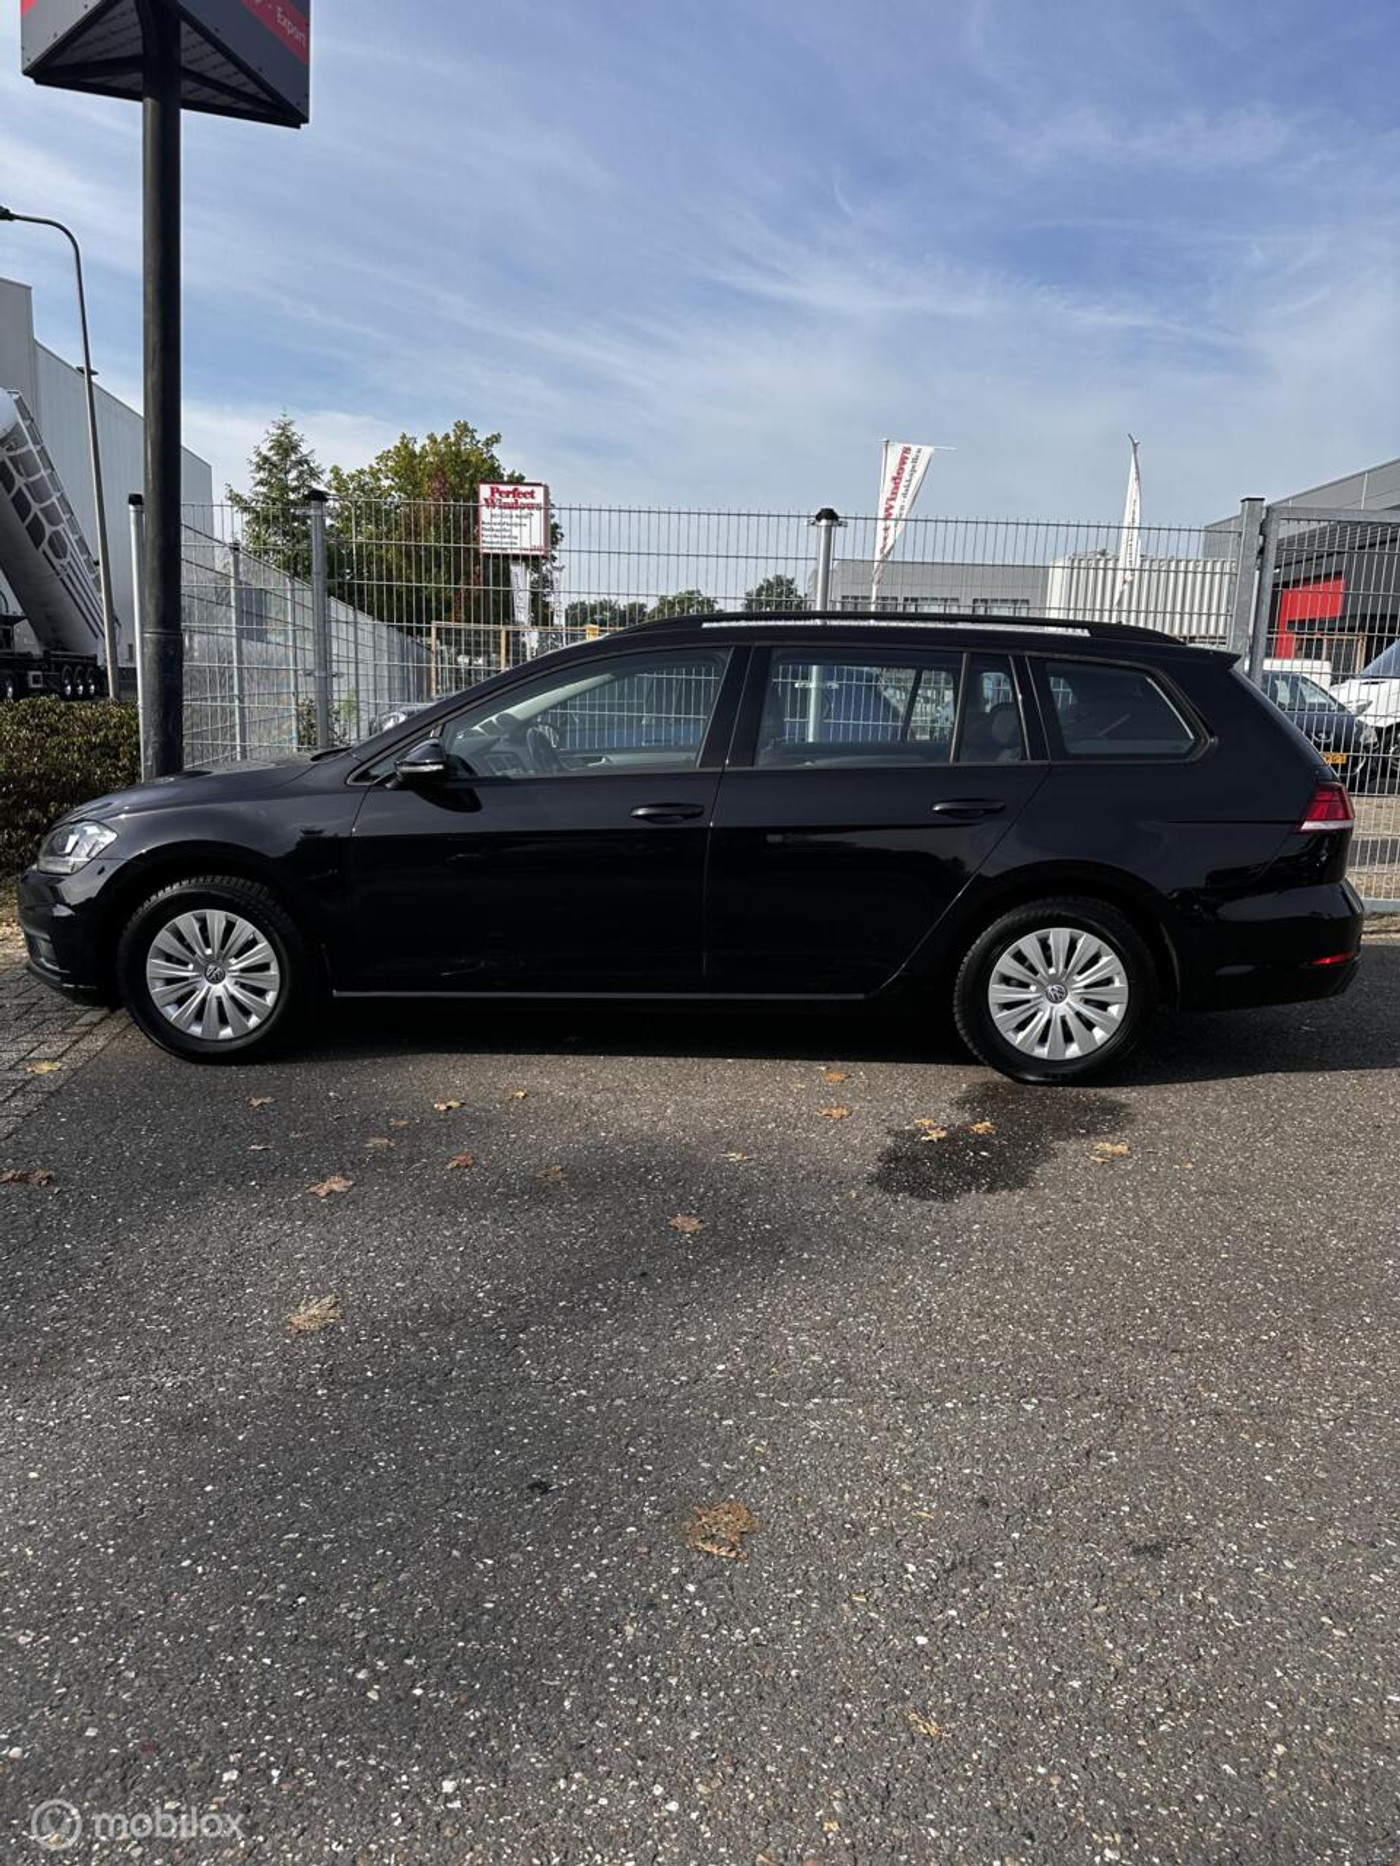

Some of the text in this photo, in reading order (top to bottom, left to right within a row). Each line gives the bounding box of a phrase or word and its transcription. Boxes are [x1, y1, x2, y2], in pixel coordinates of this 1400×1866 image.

[277, 5, 307, 48] Export
[490, 486, 536, 499] Perfect
[884, 446, 912, 519] Windows
[483, 497, 542, 511] Windows
